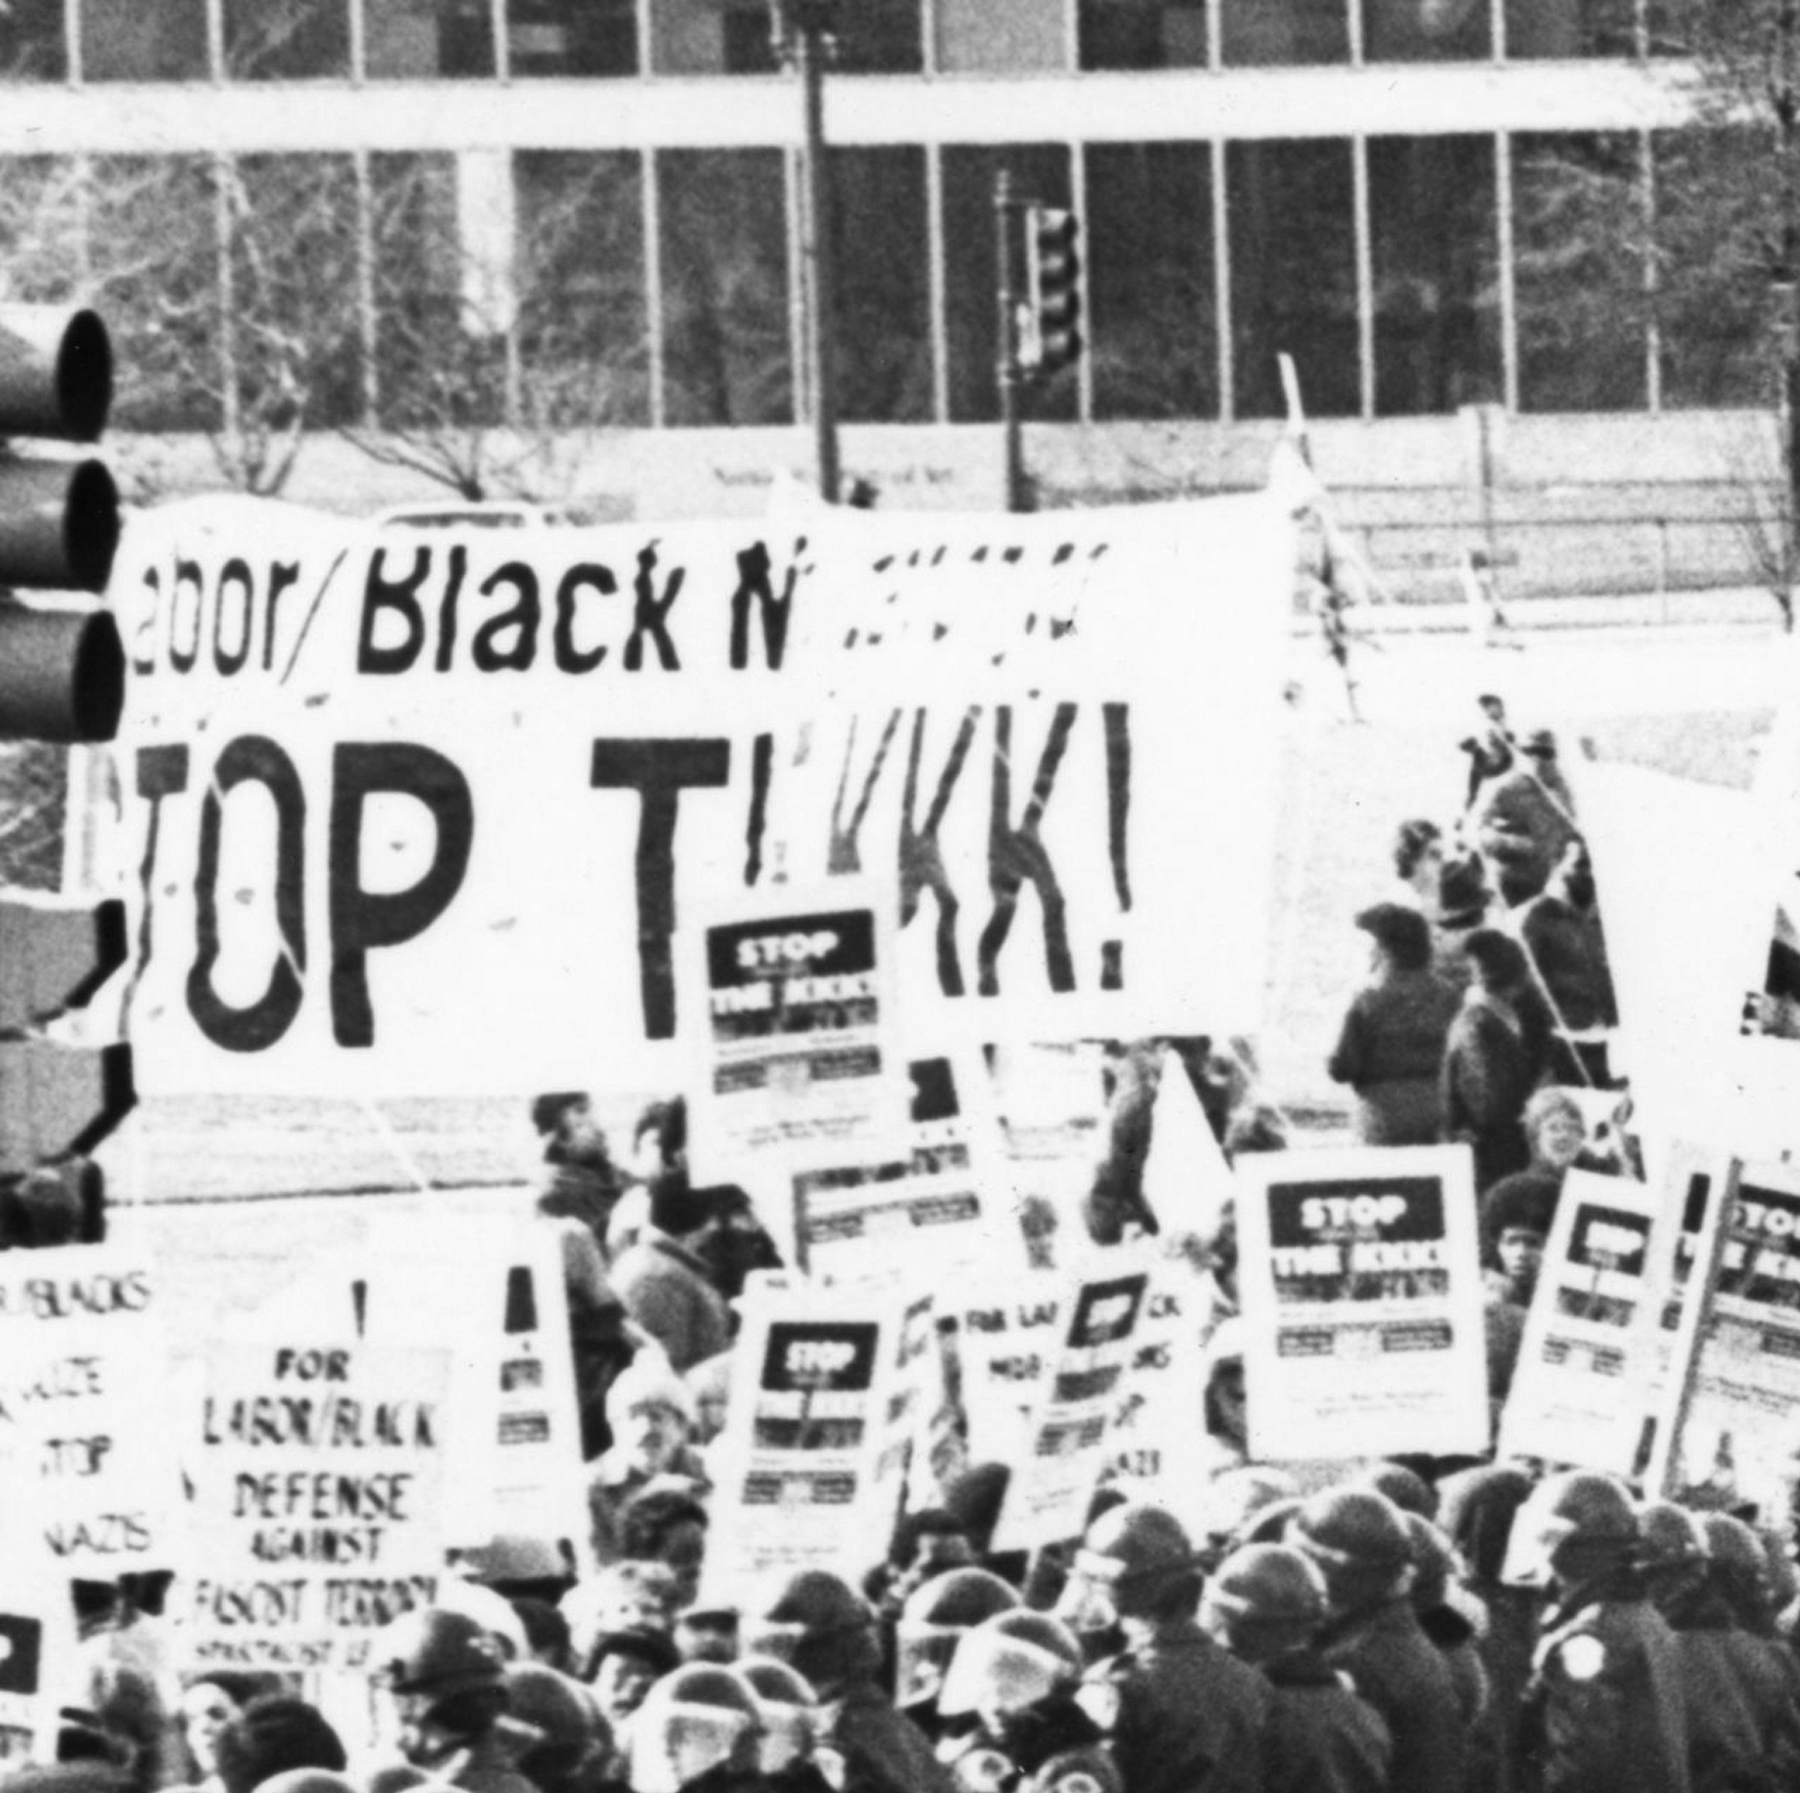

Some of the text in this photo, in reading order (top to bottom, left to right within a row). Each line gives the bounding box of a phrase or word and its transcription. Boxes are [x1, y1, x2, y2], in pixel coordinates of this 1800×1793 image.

[133, 538, 685, 684] abor/Black
[125, 735, 473, 1053] TOP
[828, 702, 1134, 997] KKK!
[737, 928, 839, 967] STOP
[1302, 1193, 1408, 1228] STOP
[275, 1348, 350, 1382] FOR
[232, 1472, 413, 1519] DEFENSE
